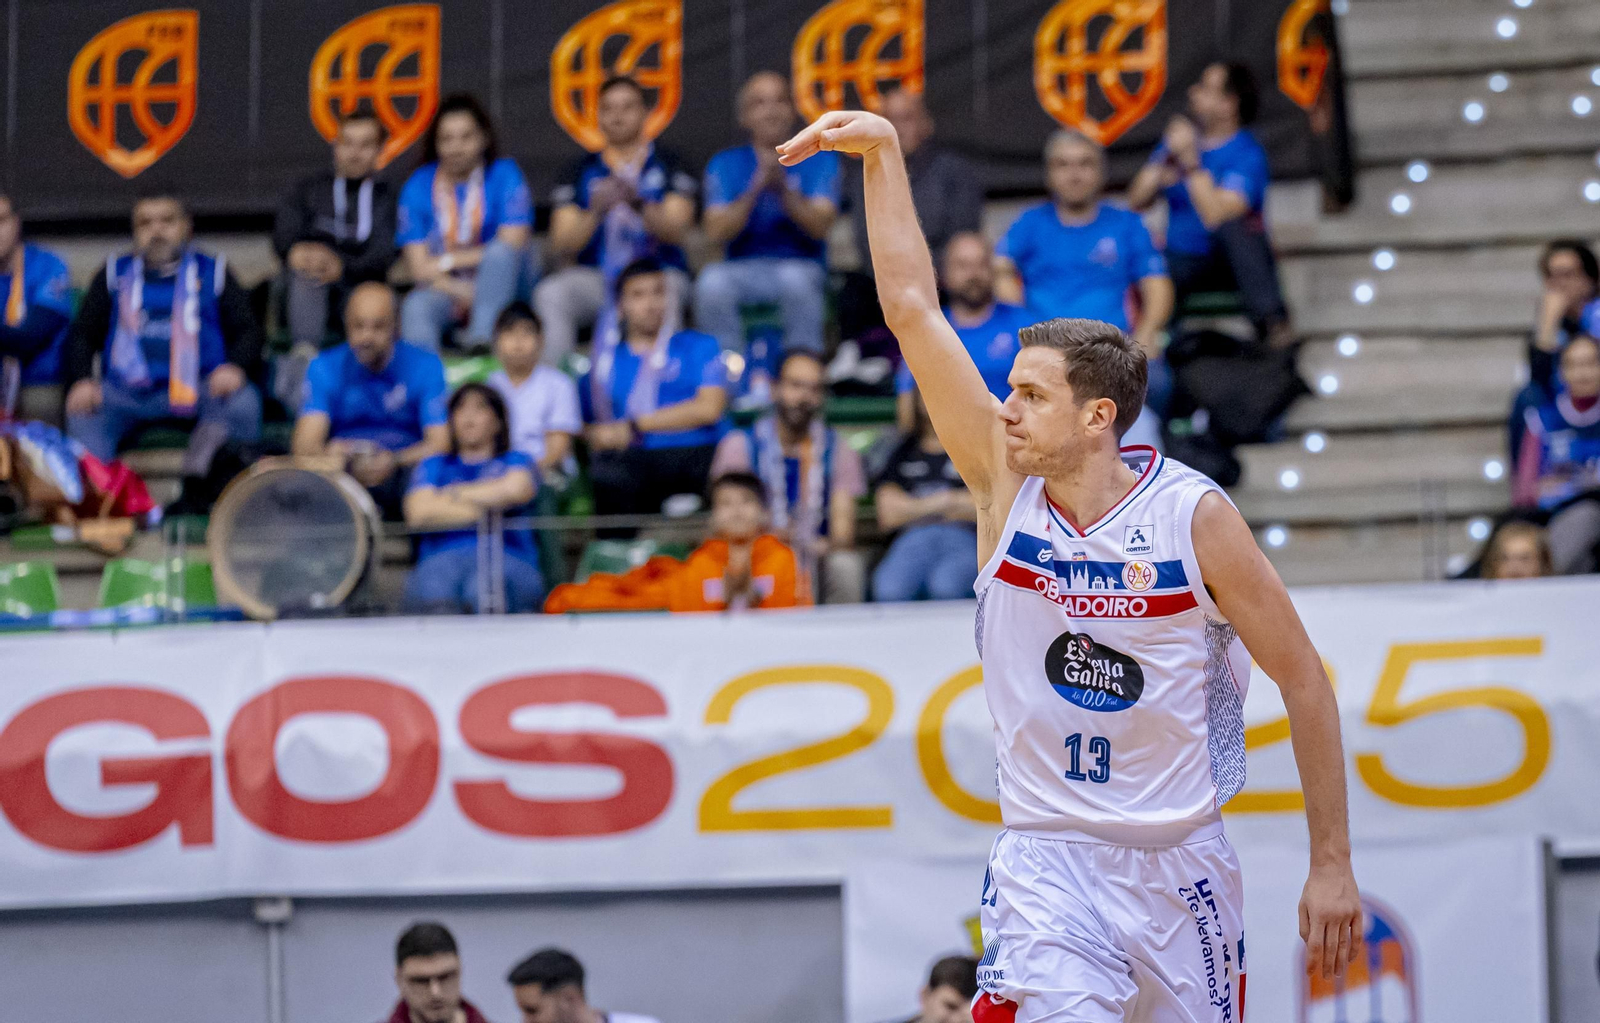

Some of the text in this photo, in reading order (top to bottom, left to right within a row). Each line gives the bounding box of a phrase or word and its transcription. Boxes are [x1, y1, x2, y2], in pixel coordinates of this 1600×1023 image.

[1125, 545, 1151, 553] CORTIZO
[1034, 577, 1148, 617] OBADOIRO
[1082, 688, 1107, 707] 0,0
[1064, 732, 1111, 784] 13
[1178, 887, 1201, 913] ¿Te
[993, 969, 1005, 980] DE
